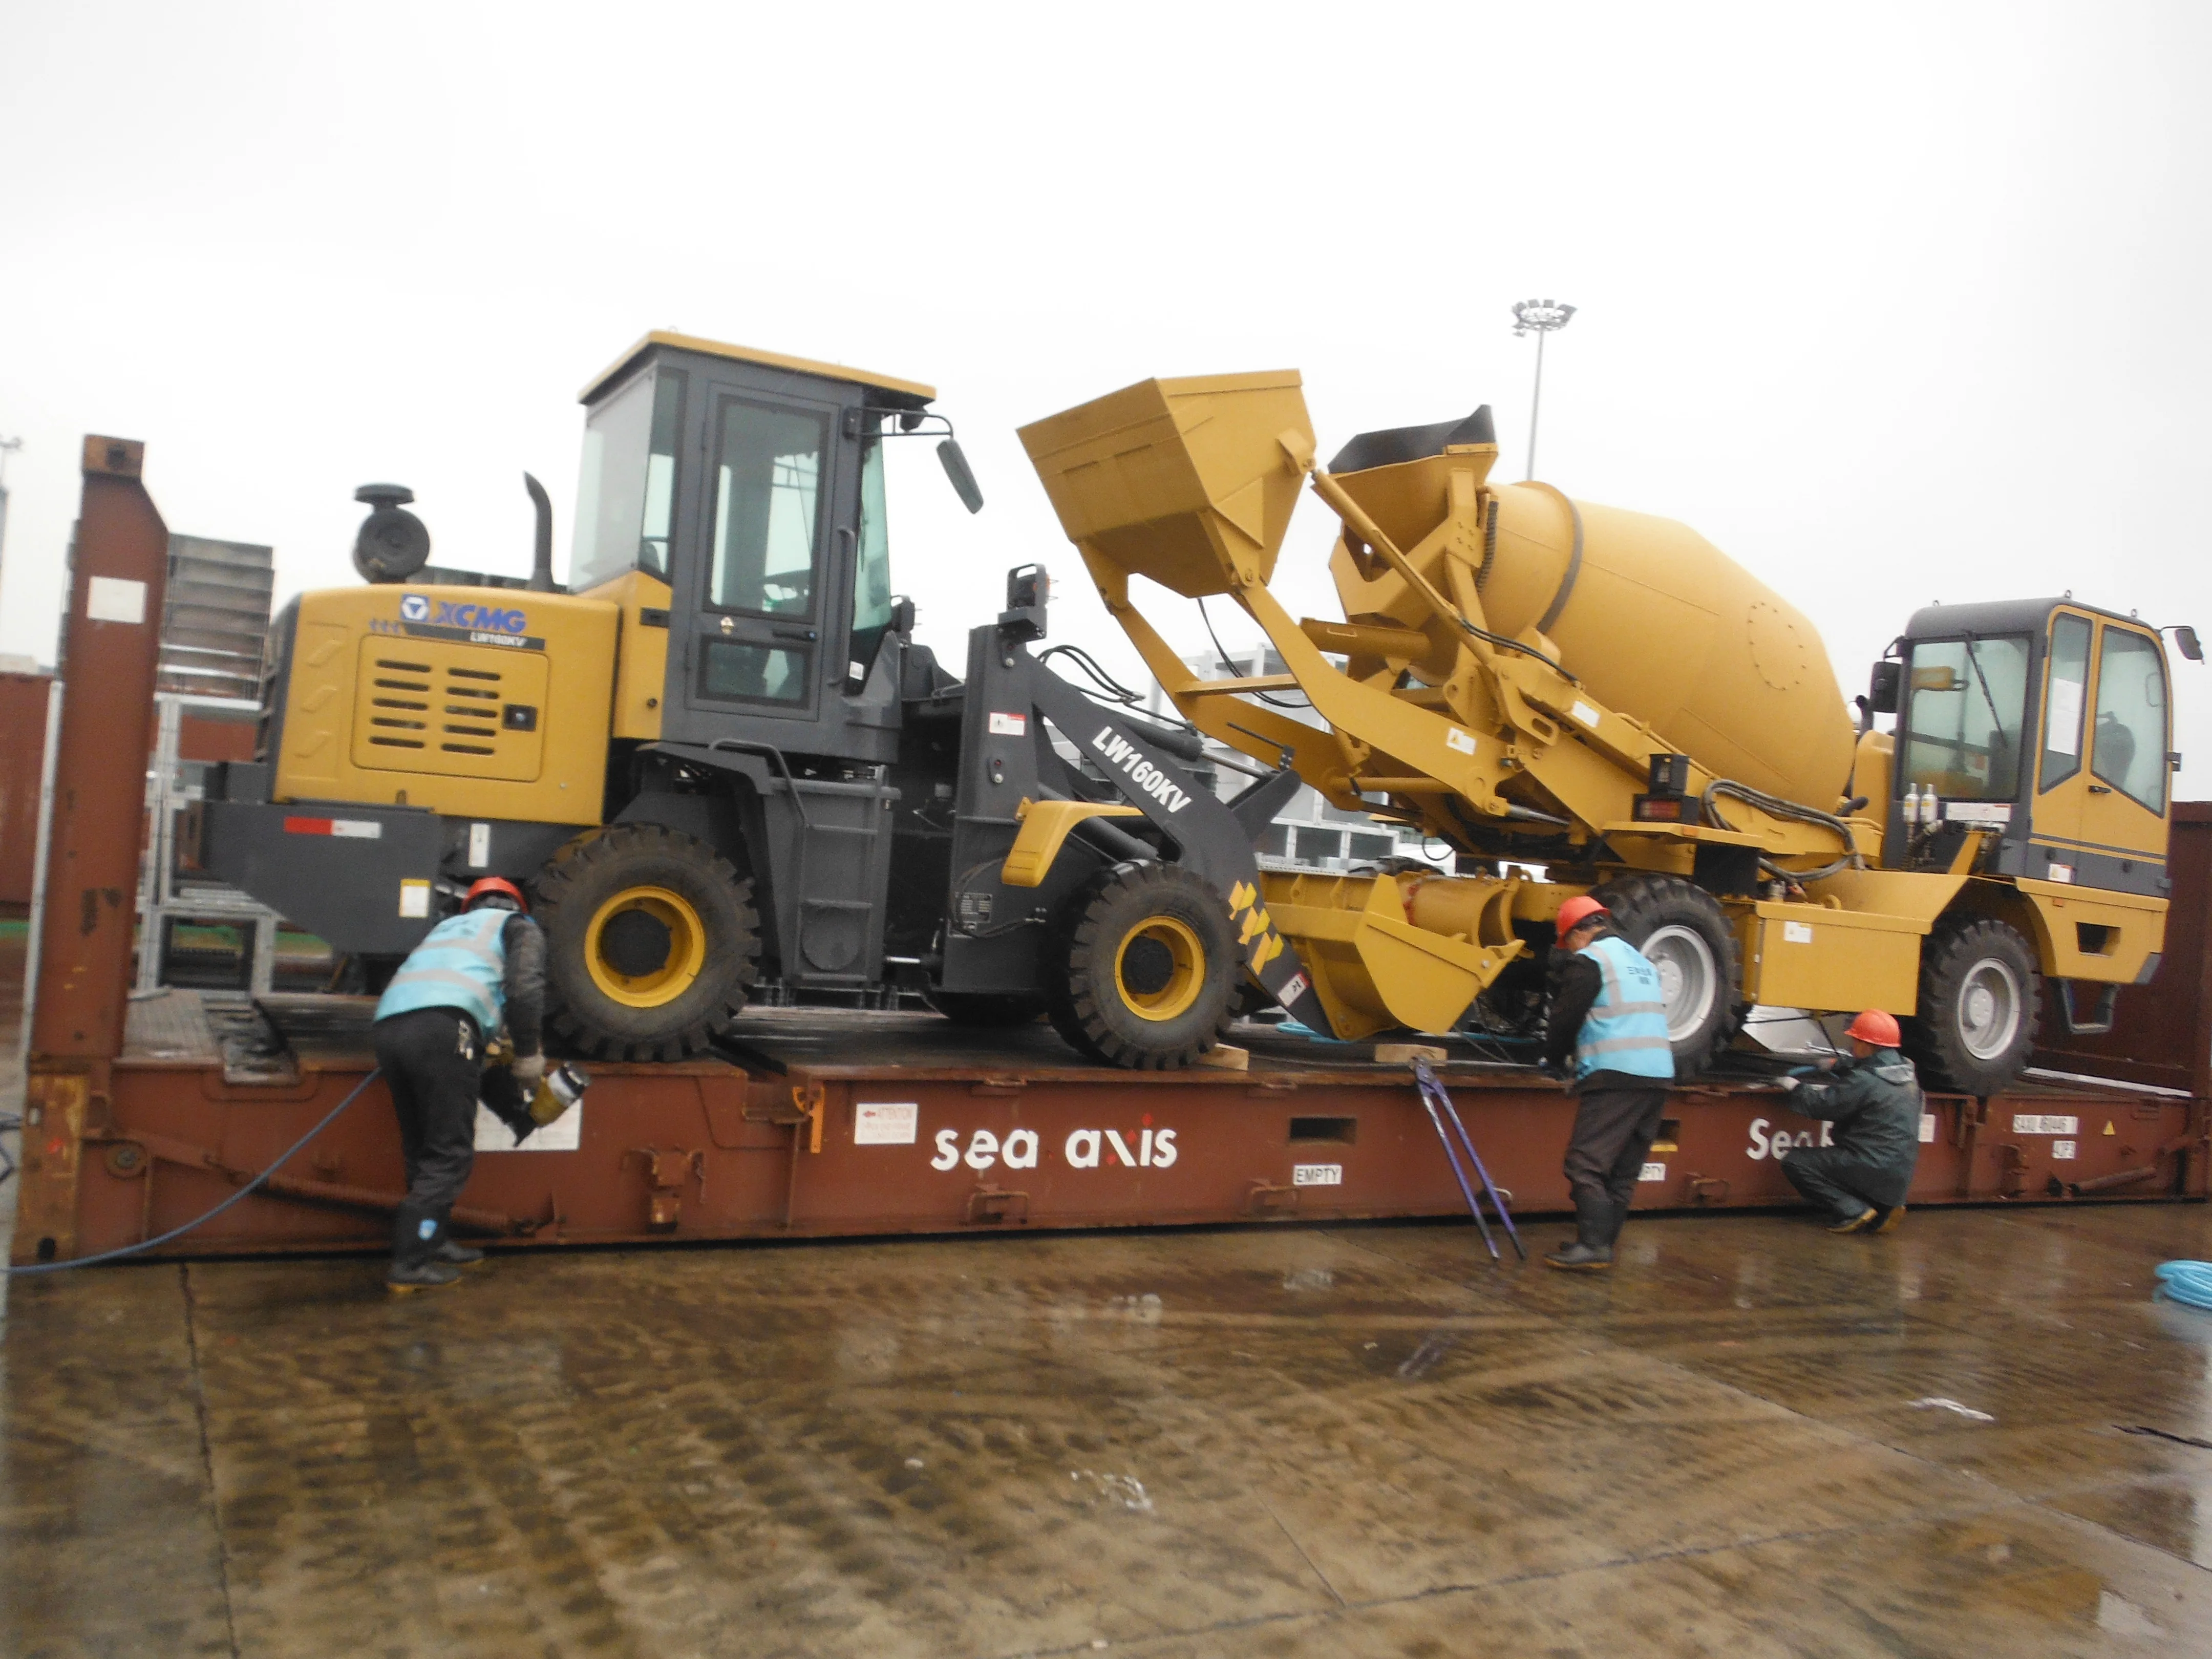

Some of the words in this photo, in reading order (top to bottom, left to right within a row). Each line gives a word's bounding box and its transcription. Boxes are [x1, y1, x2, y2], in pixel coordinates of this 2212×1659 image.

[434, 601, 526, 633] XCMG
[1092, 726, 1192, 813] LW160KV
[930, 1128, 1039, 1171] sea
[1065, 1114, 1178, 1168] axis
[1296, 1168, 1339, 1183] EMPTY
